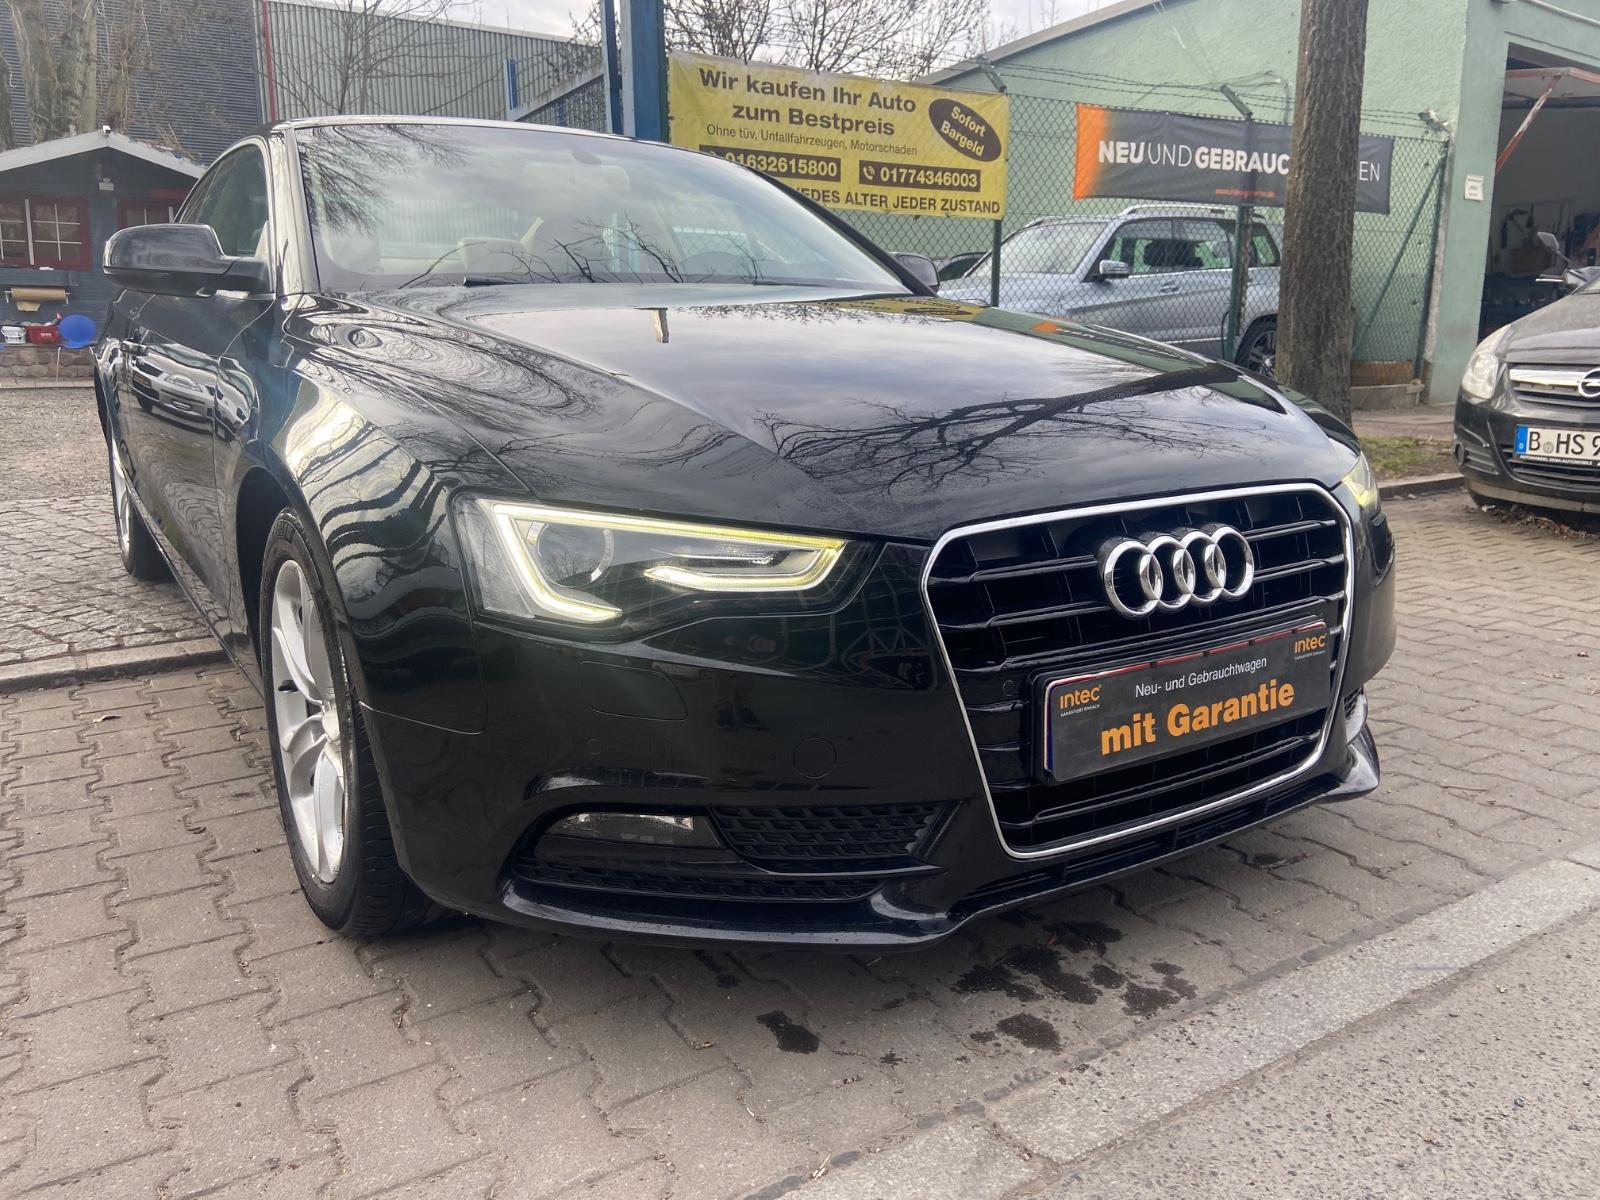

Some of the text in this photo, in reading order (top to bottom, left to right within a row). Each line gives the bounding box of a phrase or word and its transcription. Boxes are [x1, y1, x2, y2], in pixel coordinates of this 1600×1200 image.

[699, 68, 917, 113] Wir kaufen Ihr Auto
[732, 104, 895, 136] zum Bestpreis
[950, 106, 986, 137] Sofort
[706, 123, 918, 156] Ohne tüv, Unfallfahrzeugen, Motorschaden
[940, 120, 985, 157] Bargeld
[880, 168, 978, 188] 01774346003
[1194, 146, 1290, 175] GEBRAUC
[1359, 160, 1380, 182] EN
[844, 191, 888, 208] ALTER
[893, 195, 936, 211] JEDER
[940, 198, 1000, 214] ZUSTAND
[1529, 431, 1541, 451] B
[1556, 433, 1585, 455] HS
[1294, 635, 1326, 654] intec
[1135, 657, 1267, 698] Neu- und Gebrauchtwagen
[1060, 686, 1101, 709] intec
[1101, 678, 1296, 756] mit Garantie
